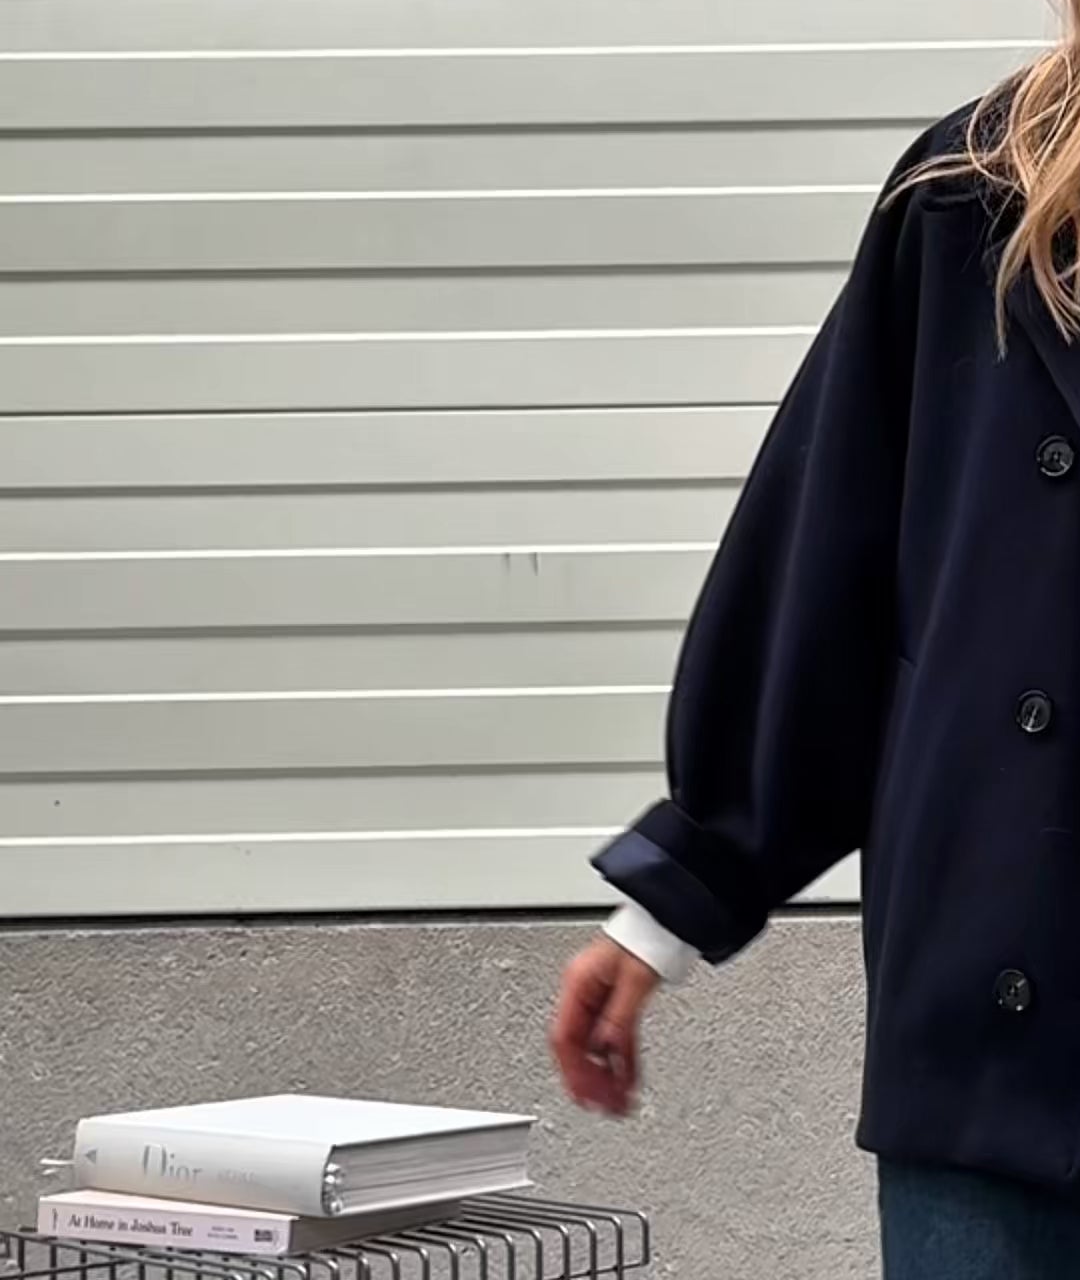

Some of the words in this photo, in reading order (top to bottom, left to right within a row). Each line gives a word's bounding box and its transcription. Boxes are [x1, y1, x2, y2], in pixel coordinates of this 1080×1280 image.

[142, 1144, 204, 1184] Dior
[68, 1214, 81, 1228] At
[83, 1215, 116, 1230] Home
[118, 1219, 129, 1231] in
[130, 1218, 168, 1234] Joshua
[170, 1221, 193, 1236] Tree
